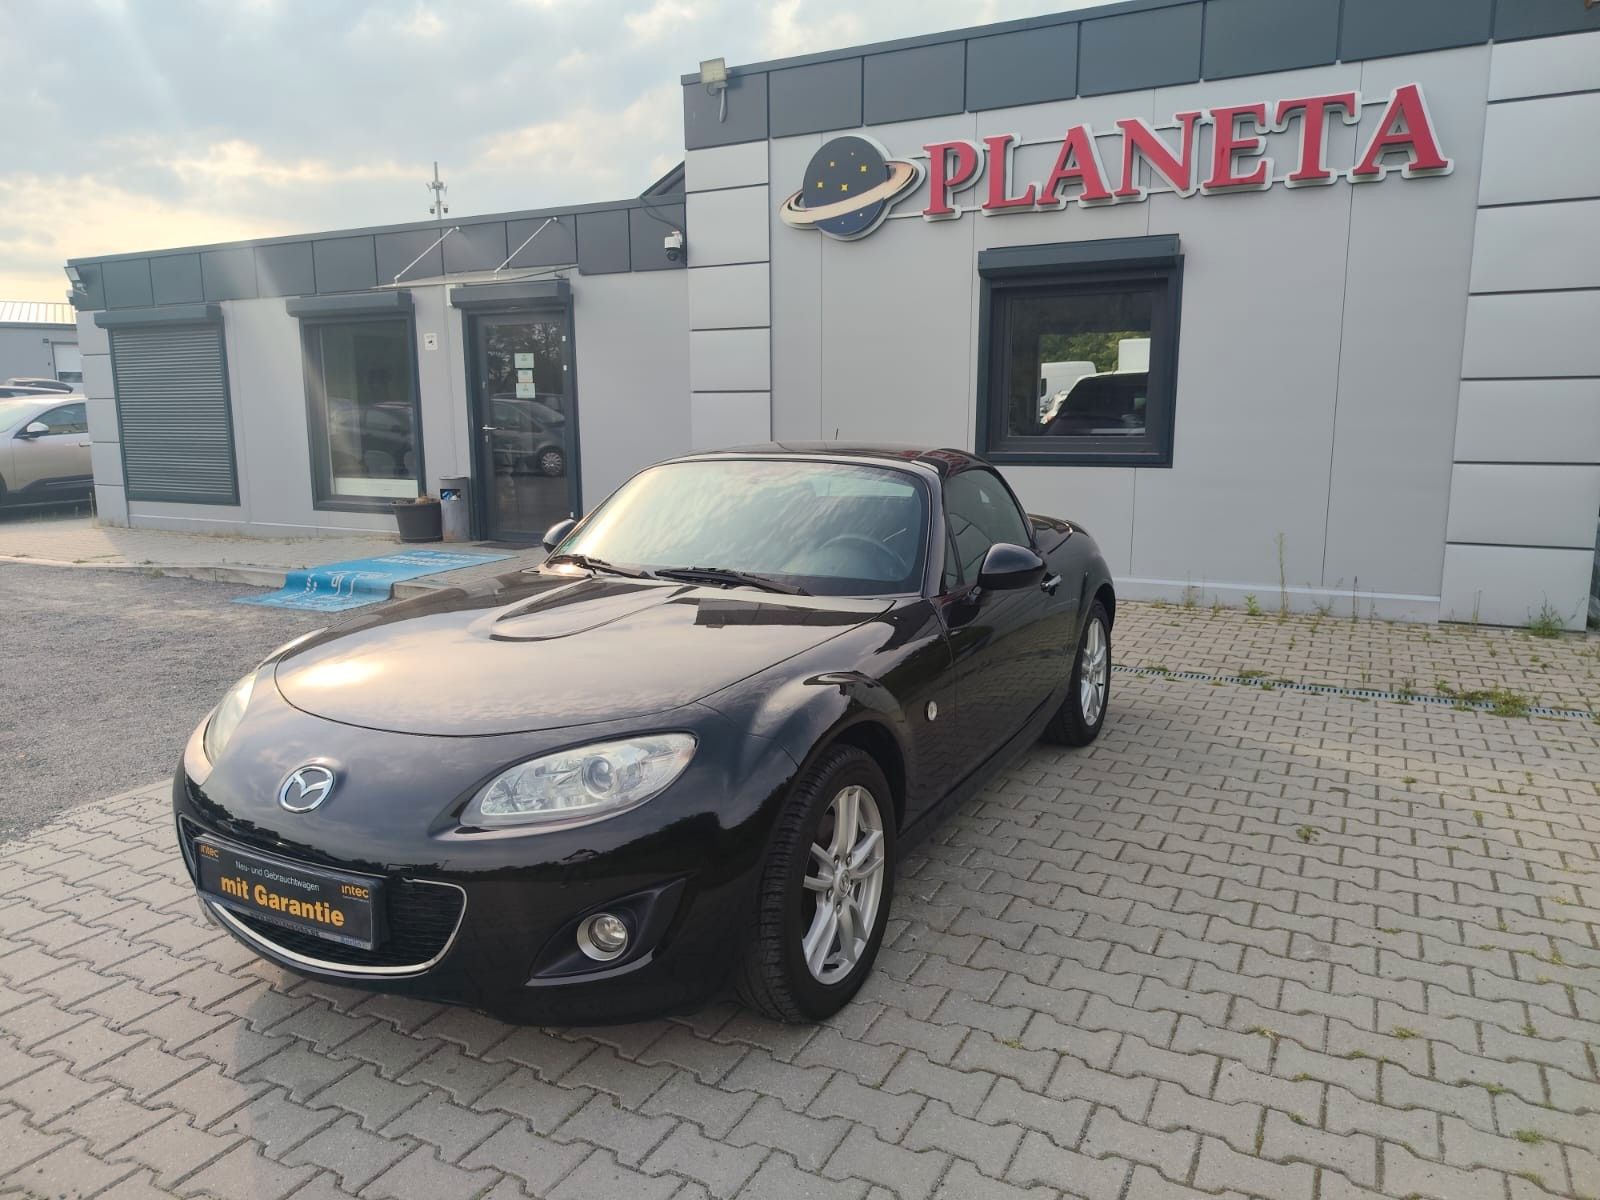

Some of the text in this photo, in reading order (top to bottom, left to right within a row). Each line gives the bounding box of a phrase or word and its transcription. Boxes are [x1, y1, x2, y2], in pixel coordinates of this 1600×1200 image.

[922, 83, 1449, 217] PLANETA
[235, 860, 320, 892] Neu- und Gebrauchtwagen
[341, 884, 369, 899] intec
[220, 876, 249, 900] mit
[254, 884, 345, 928] Garantie
